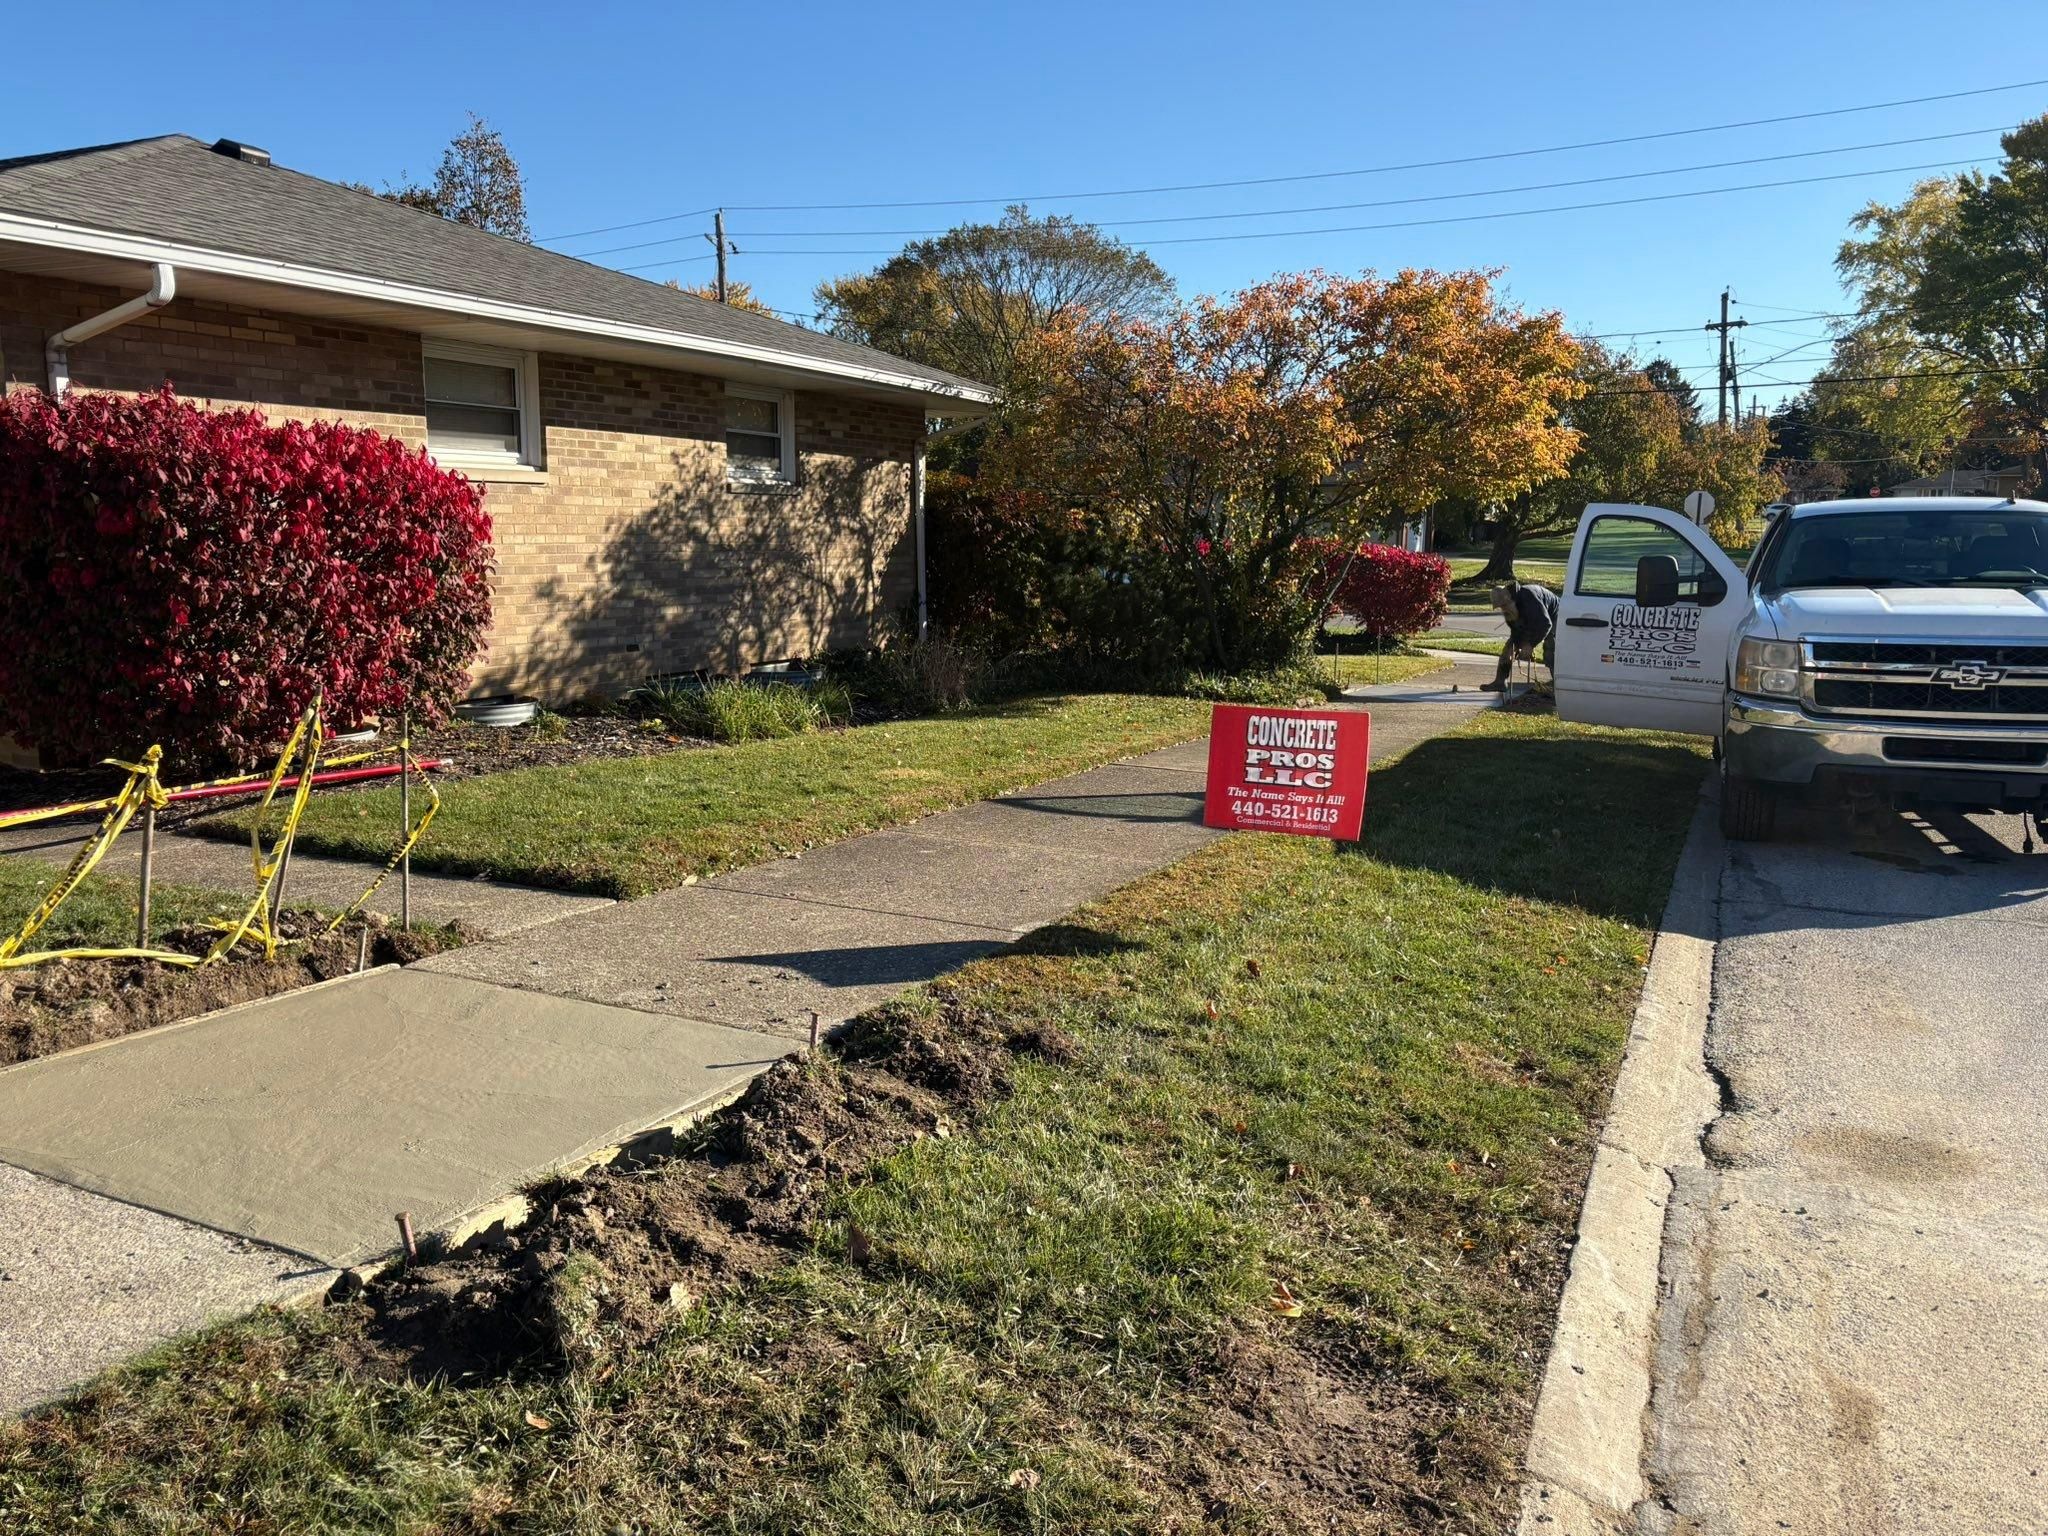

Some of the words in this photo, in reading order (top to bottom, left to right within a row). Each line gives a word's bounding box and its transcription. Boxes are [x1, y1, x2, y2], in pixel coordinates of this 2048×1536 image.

[1611, 604, 1701, 631] CONCRETE
[1610, 628, 1697, 642] PROS
[1609, 639, 1696, 654] LLC
[1617, 656, 1684, 667] 440-521-1613
[1247, 715, 1338, 750] CONCRETE
[1246, 749, 1335, 770] PROS
[1244, 766, 1333, 789] LLC
[1227, 786, 1248, 798] The
[1251, 788, 1285, 800] Name
[1287, 791, 1314, 805] Says
[1315, 794, 1325, 804] It
[1325, 795, 1345, 806] All!
[1231, 800, 1339, 824] 440-521-1613
[1236, 815, 1284, 827] Commercial
[1292, 821, 1331, 832] Residential
